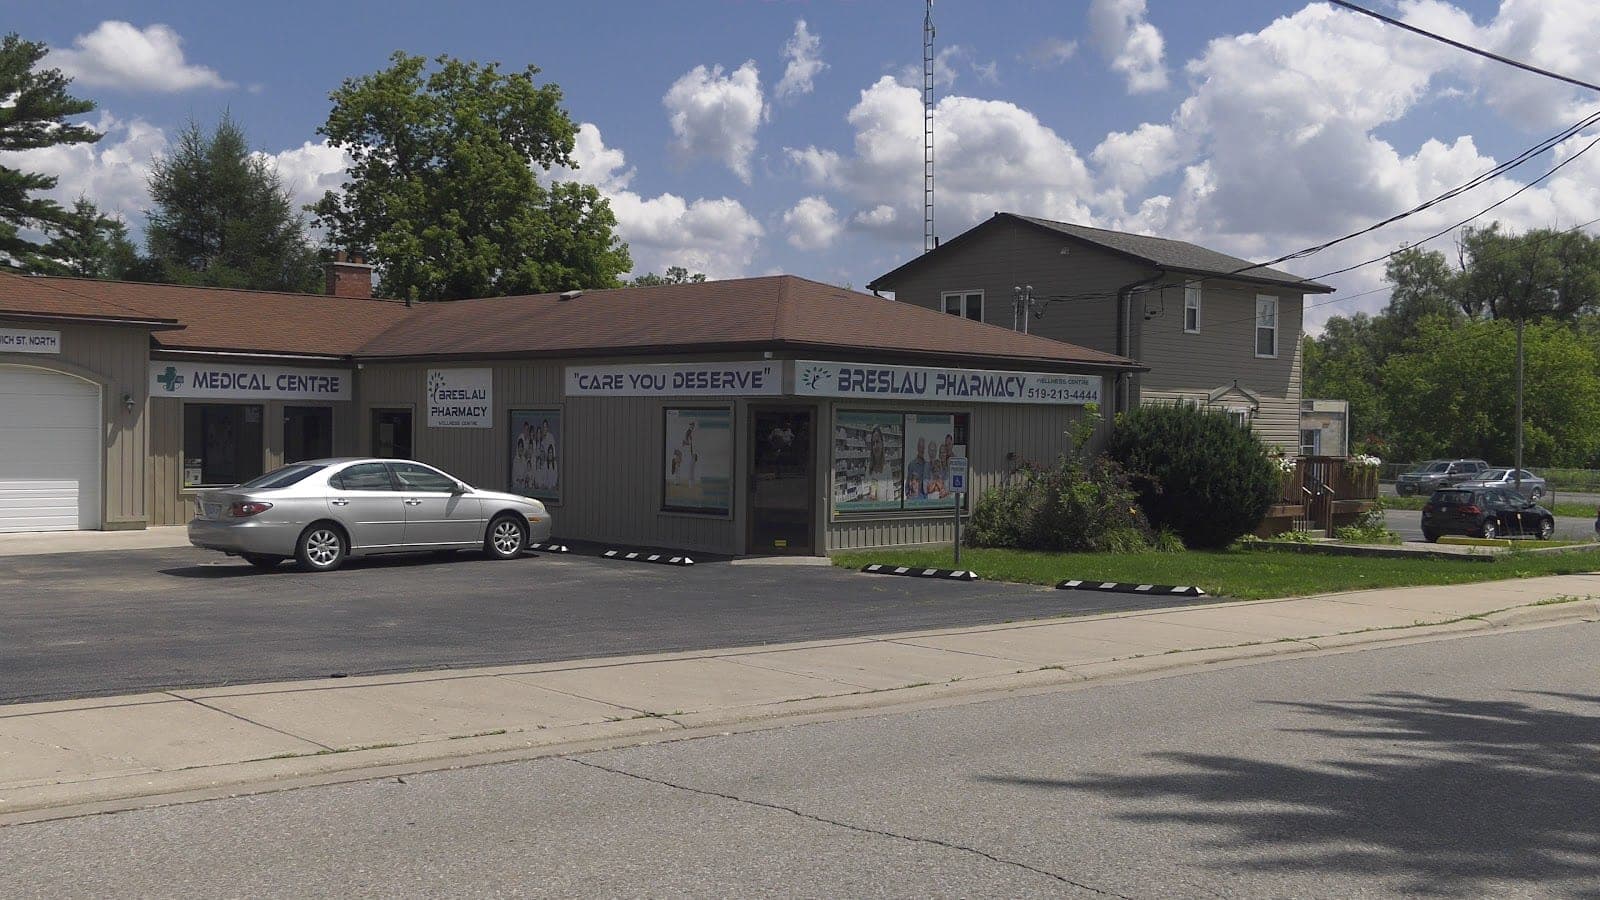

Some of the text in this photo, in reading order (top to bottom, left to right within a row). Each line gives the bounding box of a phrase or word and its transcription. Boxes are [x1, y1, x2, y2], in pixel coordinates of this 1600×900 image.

[0, 335, 14, 345] ICH
[29, 336, 56, 346] NORTH
[193, 371, 340, 393] MEDICAL CENTRE
[629, 374, 666, 391] YOU
[837, 368, 1026, 398] BRESLAU PHARMACY
[438, 389, 486, 400] BRESLAU
[1027, 388, 1098, 401] 519-213-4444
[431, 406, 488, 417] PHARMACY
